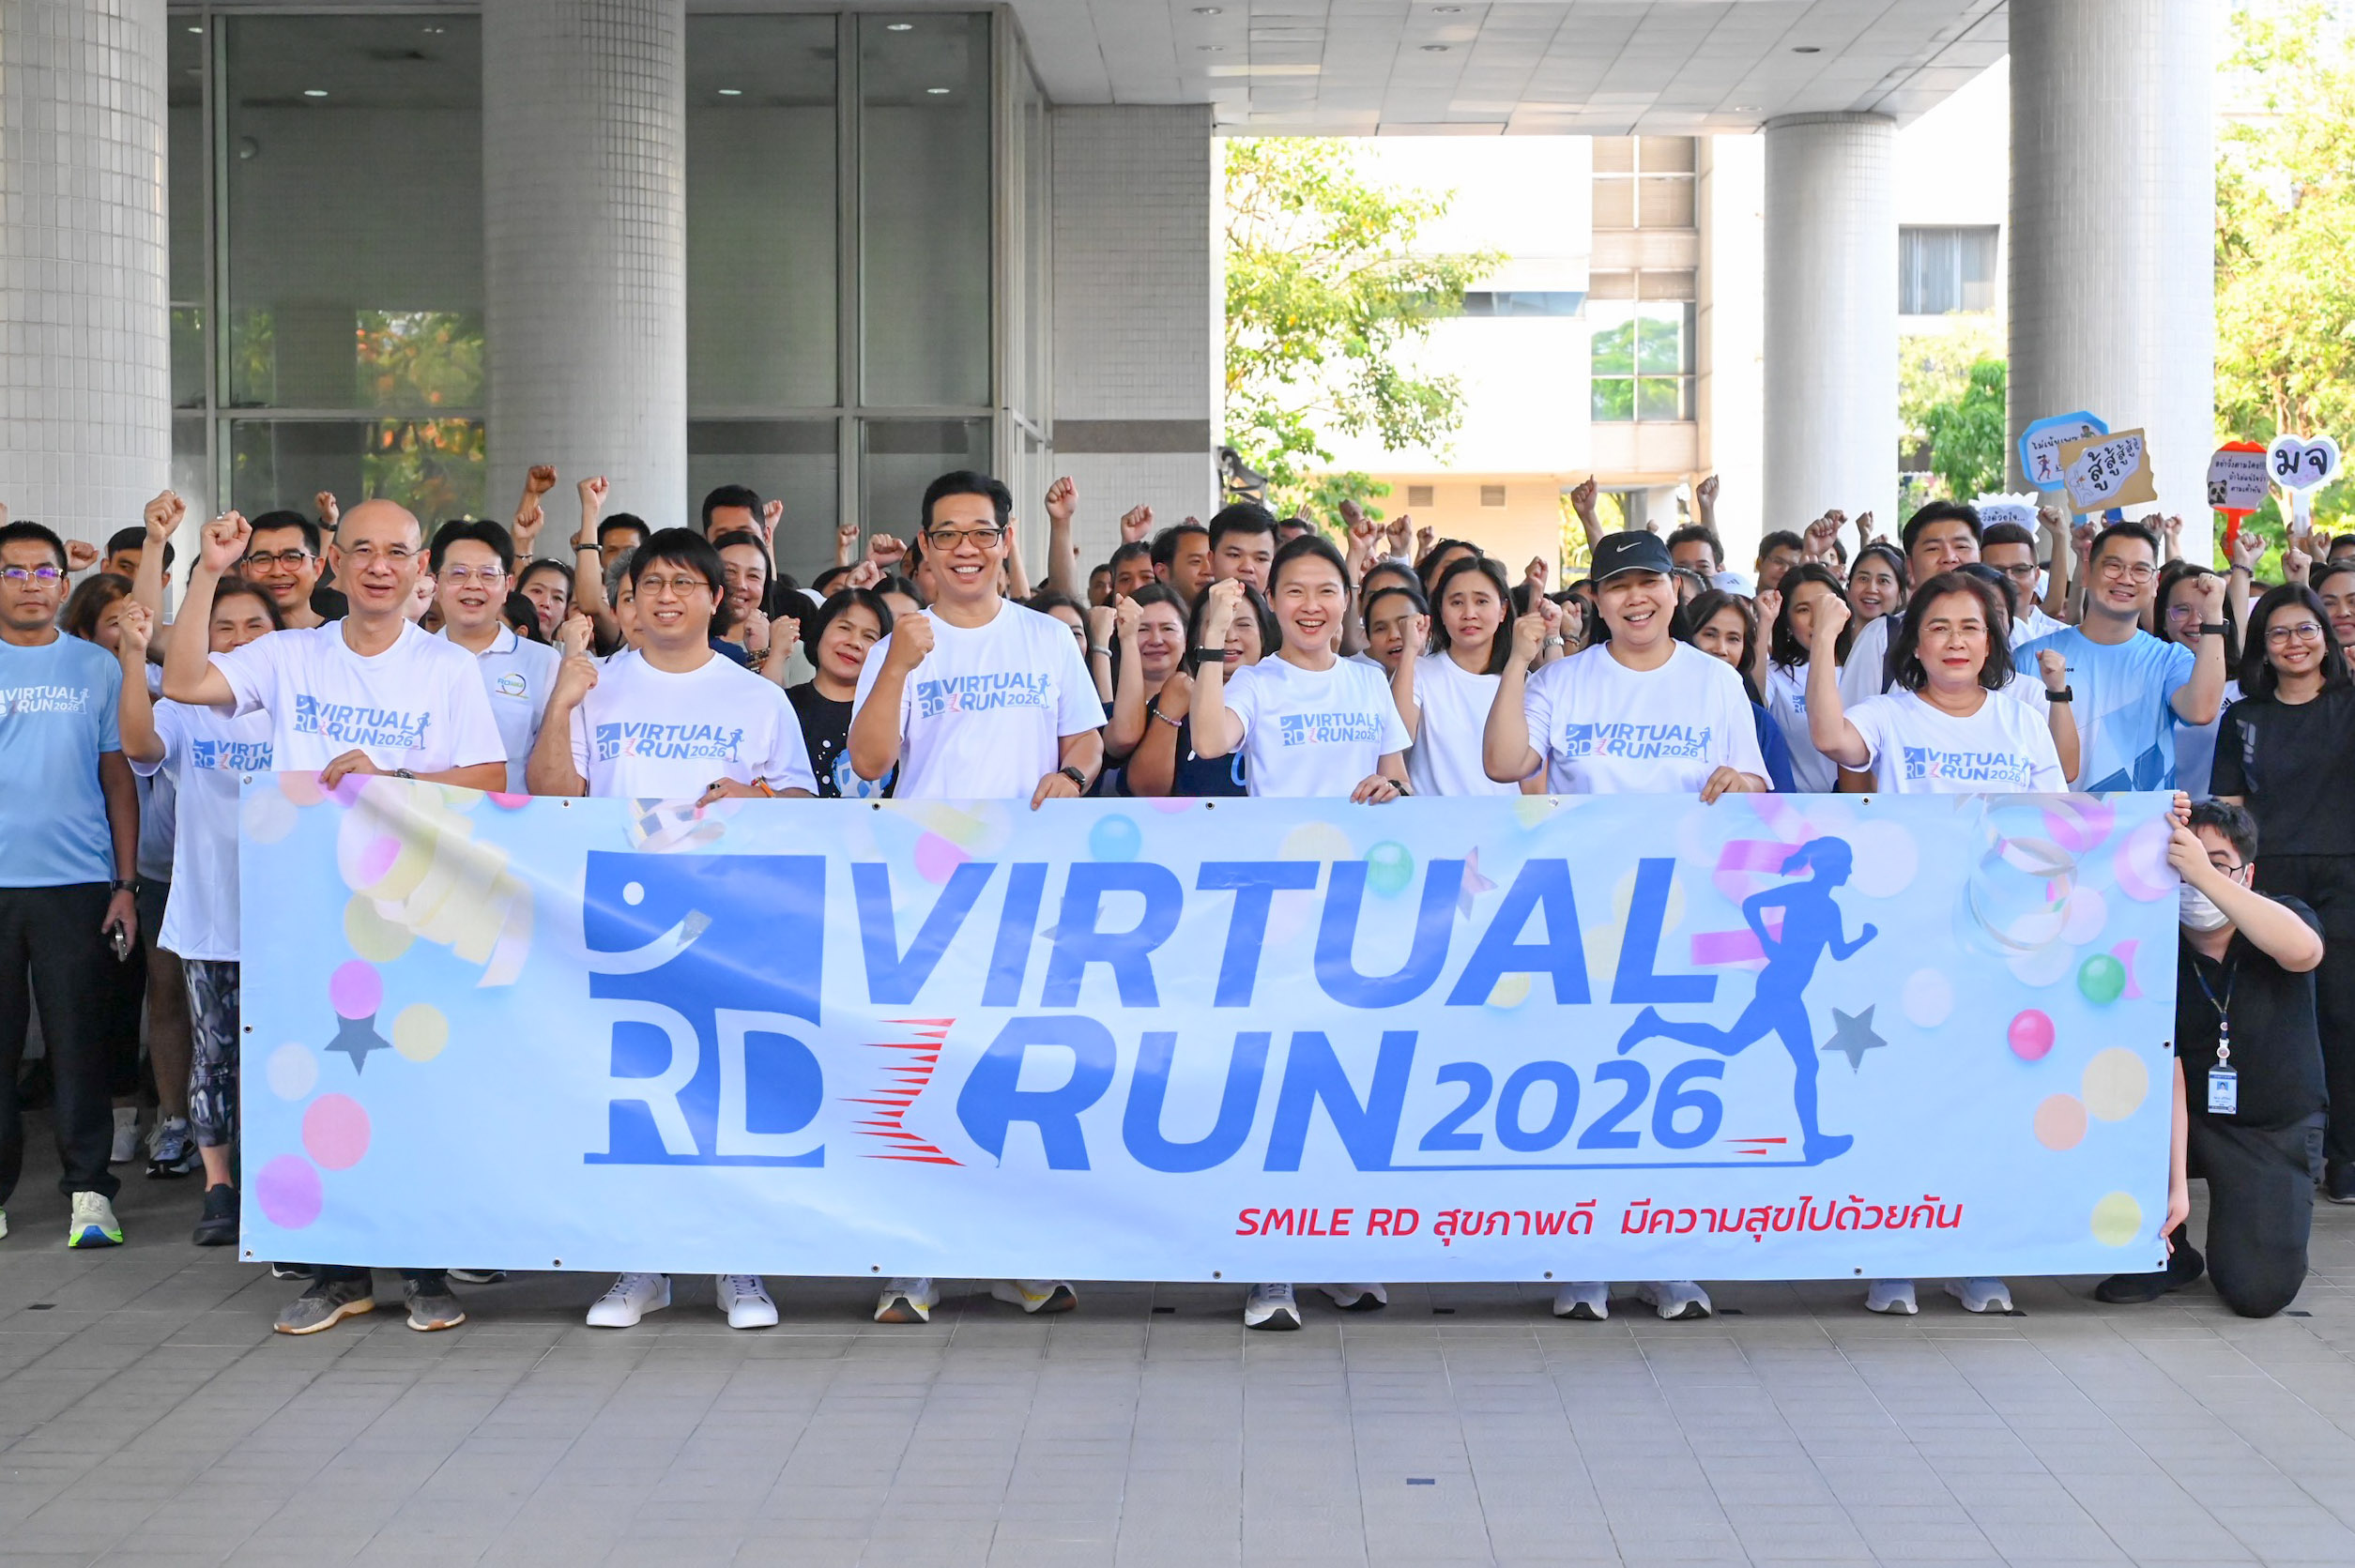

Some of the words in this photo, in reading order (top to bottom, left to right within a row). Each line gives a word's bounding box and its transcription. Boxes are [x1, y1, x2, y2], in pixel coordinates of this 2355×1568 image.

[942, 673, 1037, 694] VIRTUAL
[6, 686, 79, 702] VIRTUAL
[959, 691, 1006, 710] RUN
[1007, 693, 1040, 705] 2026
[17, 699, 54, 713] RUN
[54, 701, 79, 711] 2026
[920, 696, 945, 719] RD
[294, 711, 319, 734] RD
[315, 702, 414, 730] VIRTUAL
[1304, 713, 1374, 727] VIRTUAL
[328, 723, 378, 746] RUN
[376, 733, 413, 747] 2026
[624, 723, 726, 742] VIRTUAL
[1283, 729, 1305, 746] RD
[1317, 727, 1353, 742] RUN
[1354, 730, 1376, 740] 2026
[1595, 723, 1697, 742] VIRTUAL
[599, 739, 620, 761] RD
[635, 738, 691, 759] RUN
[690, 745, 726, 757] 2026
[1566, 738, 1592, 757] RD
[1607, 738, 1661, 759] RUN
[1661, 745, 1698, 757] 2026
[193, 752, 215, 769] RD
[232, 754, 272, 769] RUN
[1928, 748, 2020, 767] VIRTUAL
[1905, 762, 1926, 780] RD
[1940, 765, 1989, 781] RUN
[1990, 769, 2021, 783] 2026
[850, 858, 1719, 1009] VIRTUAL
[586, 997, 826, 1158] RD
[956, 1014, 1419, 1174] RUN
[1418, 1058, 1726, 1152] 2026
[1235, 1208, 1353, 1236] SMILE
[1366, 1208, 1420, 1236] RD
[1432, 1198, 1598, 1247] สุขภาพดี
[1621, 1195, 1964, 1243] มีความสุขไปด้วยกัน
